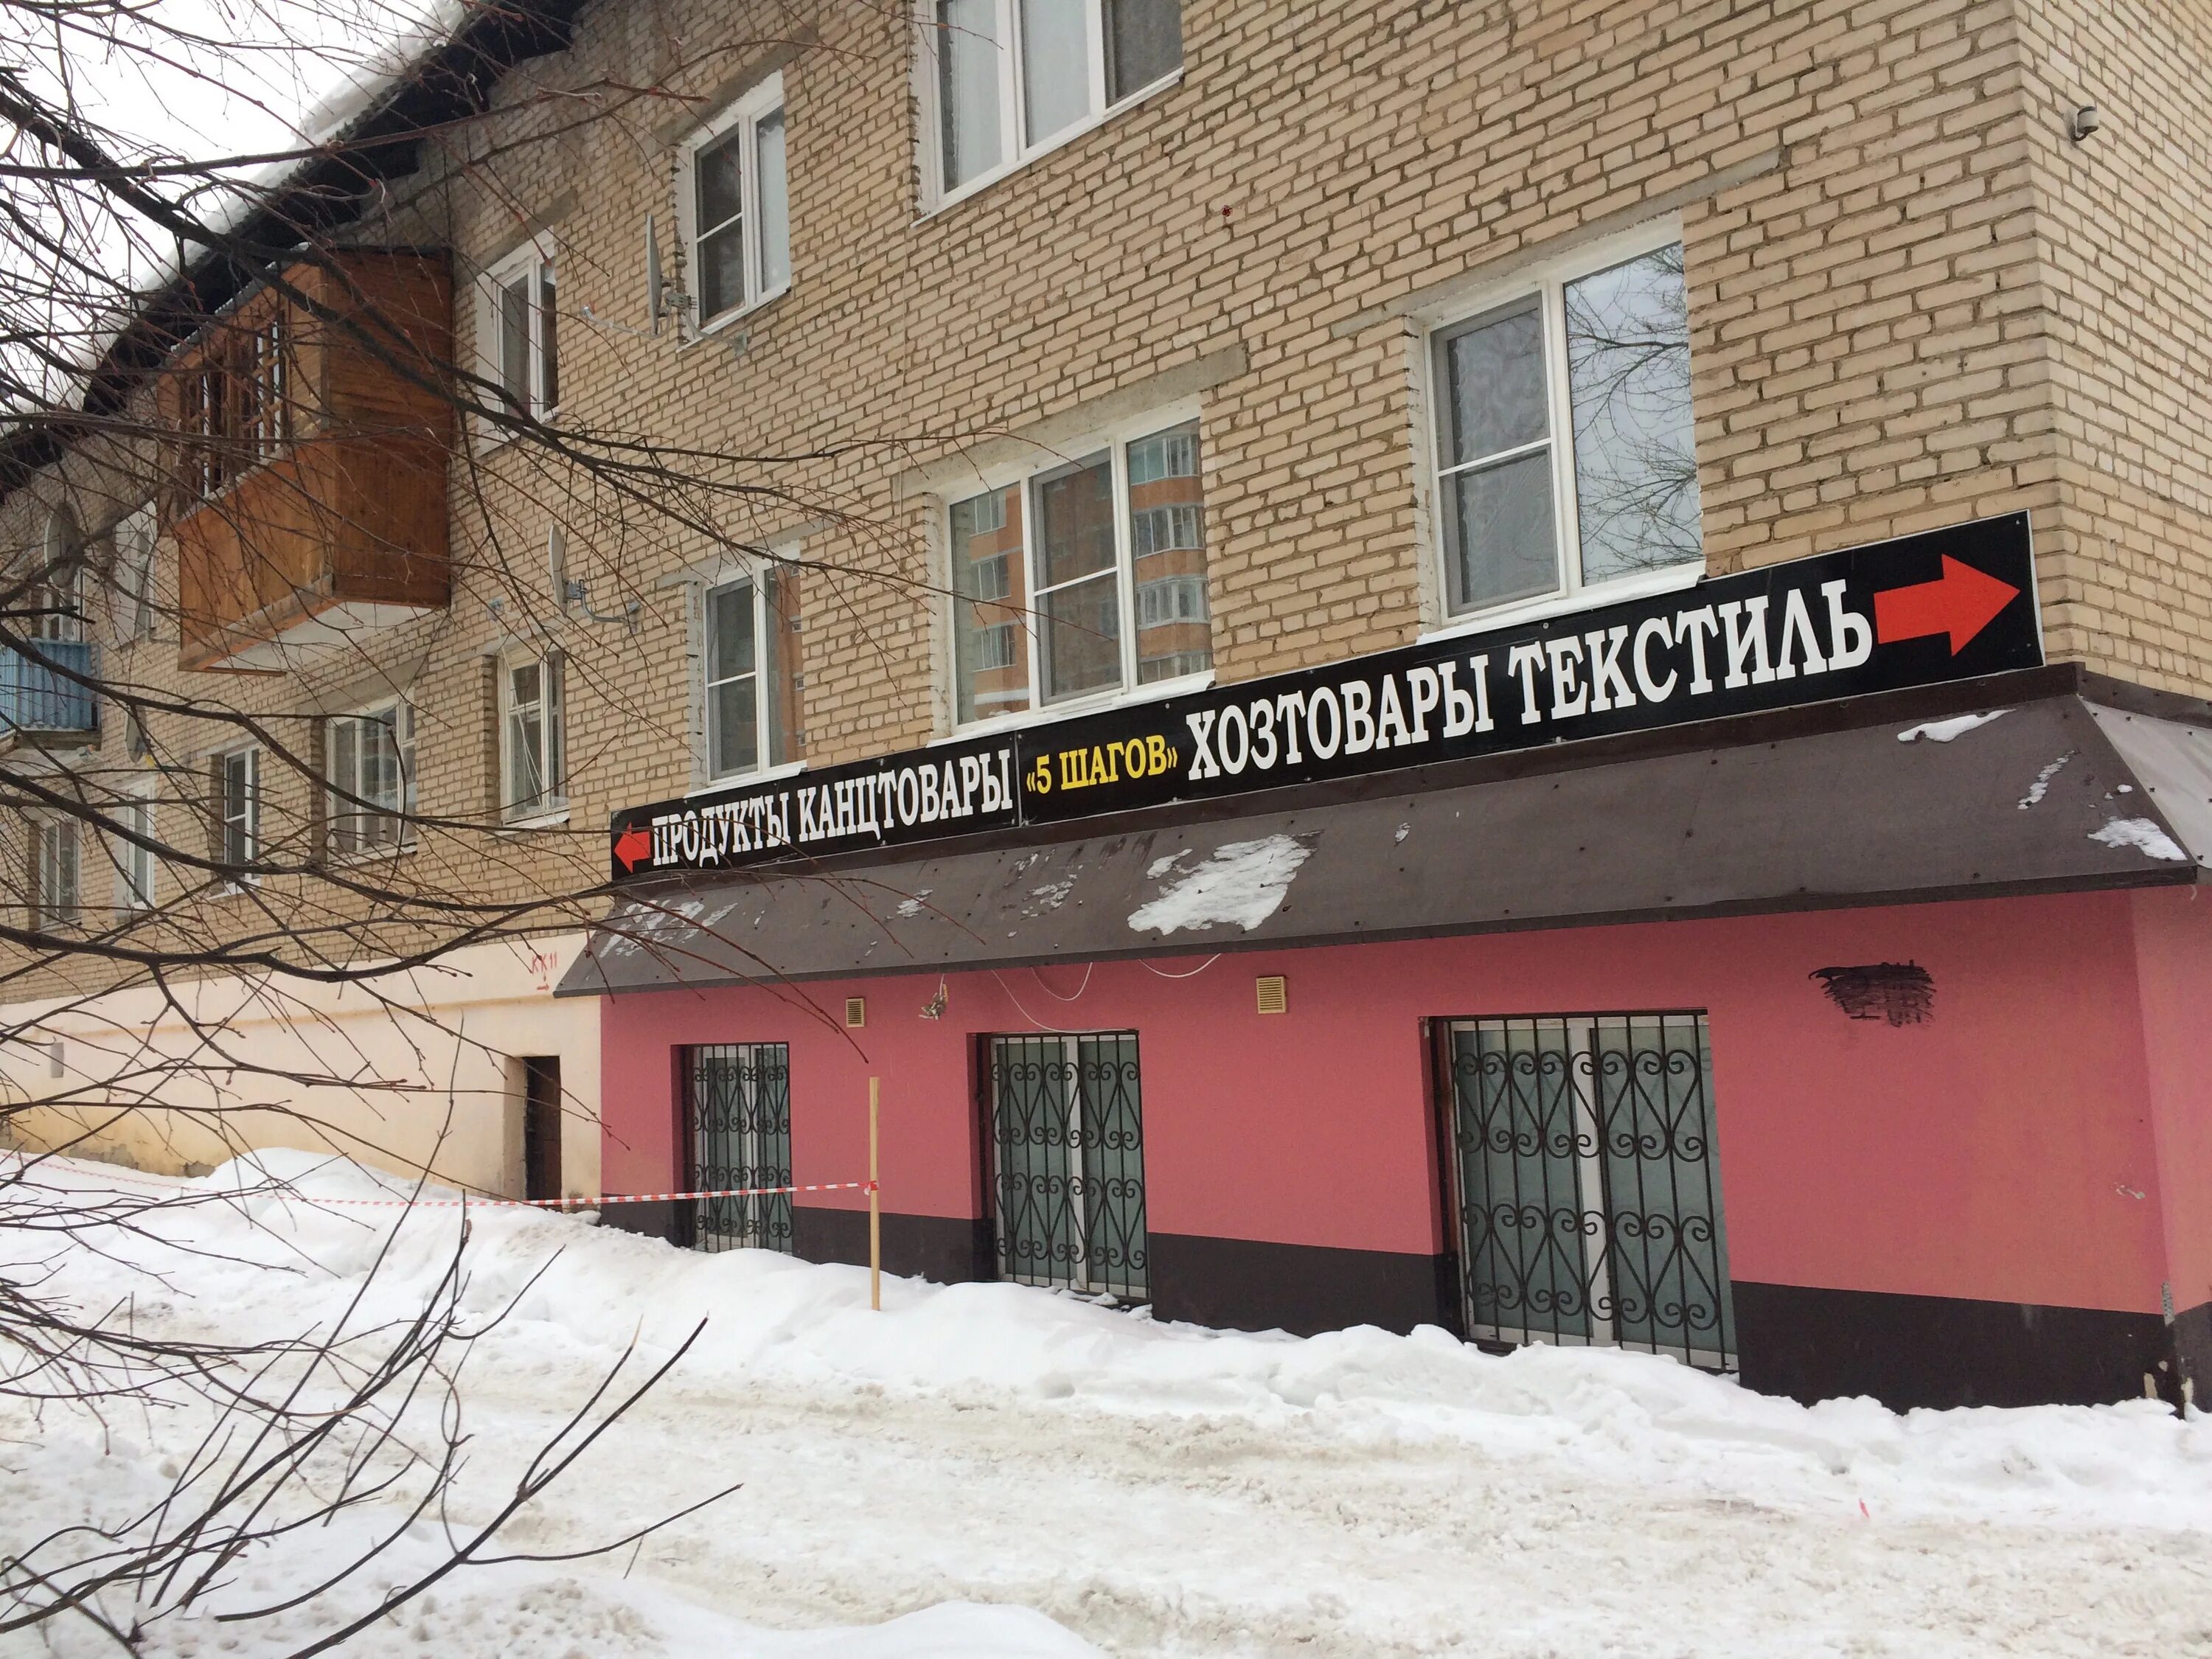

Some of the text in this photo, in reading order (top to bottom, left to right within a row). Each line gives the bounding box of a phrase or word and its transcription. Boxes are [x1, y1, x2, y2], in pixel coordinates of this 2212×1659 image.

[1026, 579, 1873, 795] «5 ШАГОВ» ХОЗТОВАРЫ ТЕКСТИЛЬ
[652, 748, 1013, 868] ПРОДУКТЫ КАНЦТОВАРЫ
